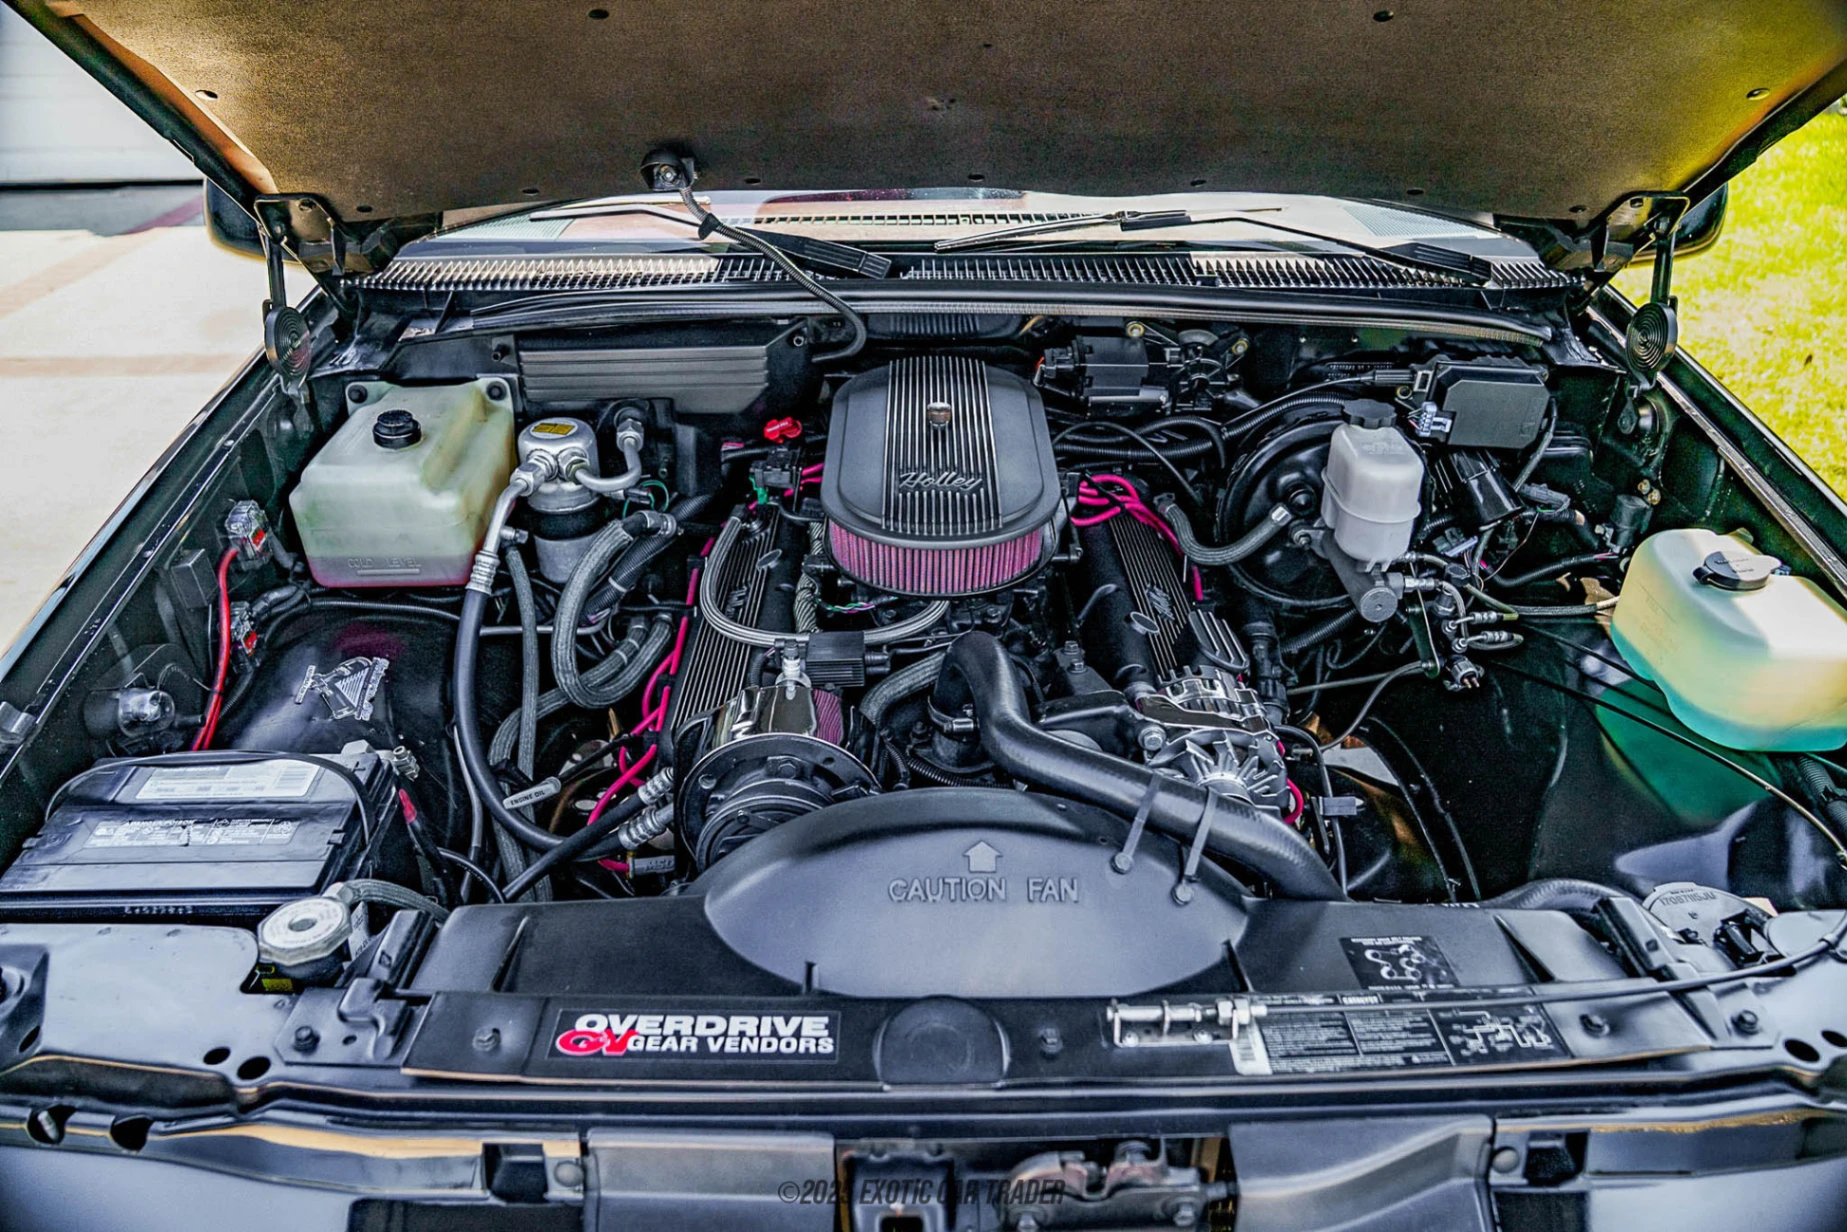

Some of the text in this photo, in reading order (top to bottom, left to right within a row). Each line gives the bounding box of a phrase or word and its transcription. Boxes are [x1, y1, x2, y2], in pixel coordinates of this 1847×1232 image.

[899, 471, 982, 490] Holley
[348, 557, 421, 569] COLD LEVEL
[510, 789, 546, 806] ENGINE OIL
[888, 877, 1079, 903] CAUTION FAN
[575, 1013, 829, 1038] OVERDRIVE
[626, 1035, 698, 1053] GEAR
[706, 1036, 835, 1054] VENDORS
